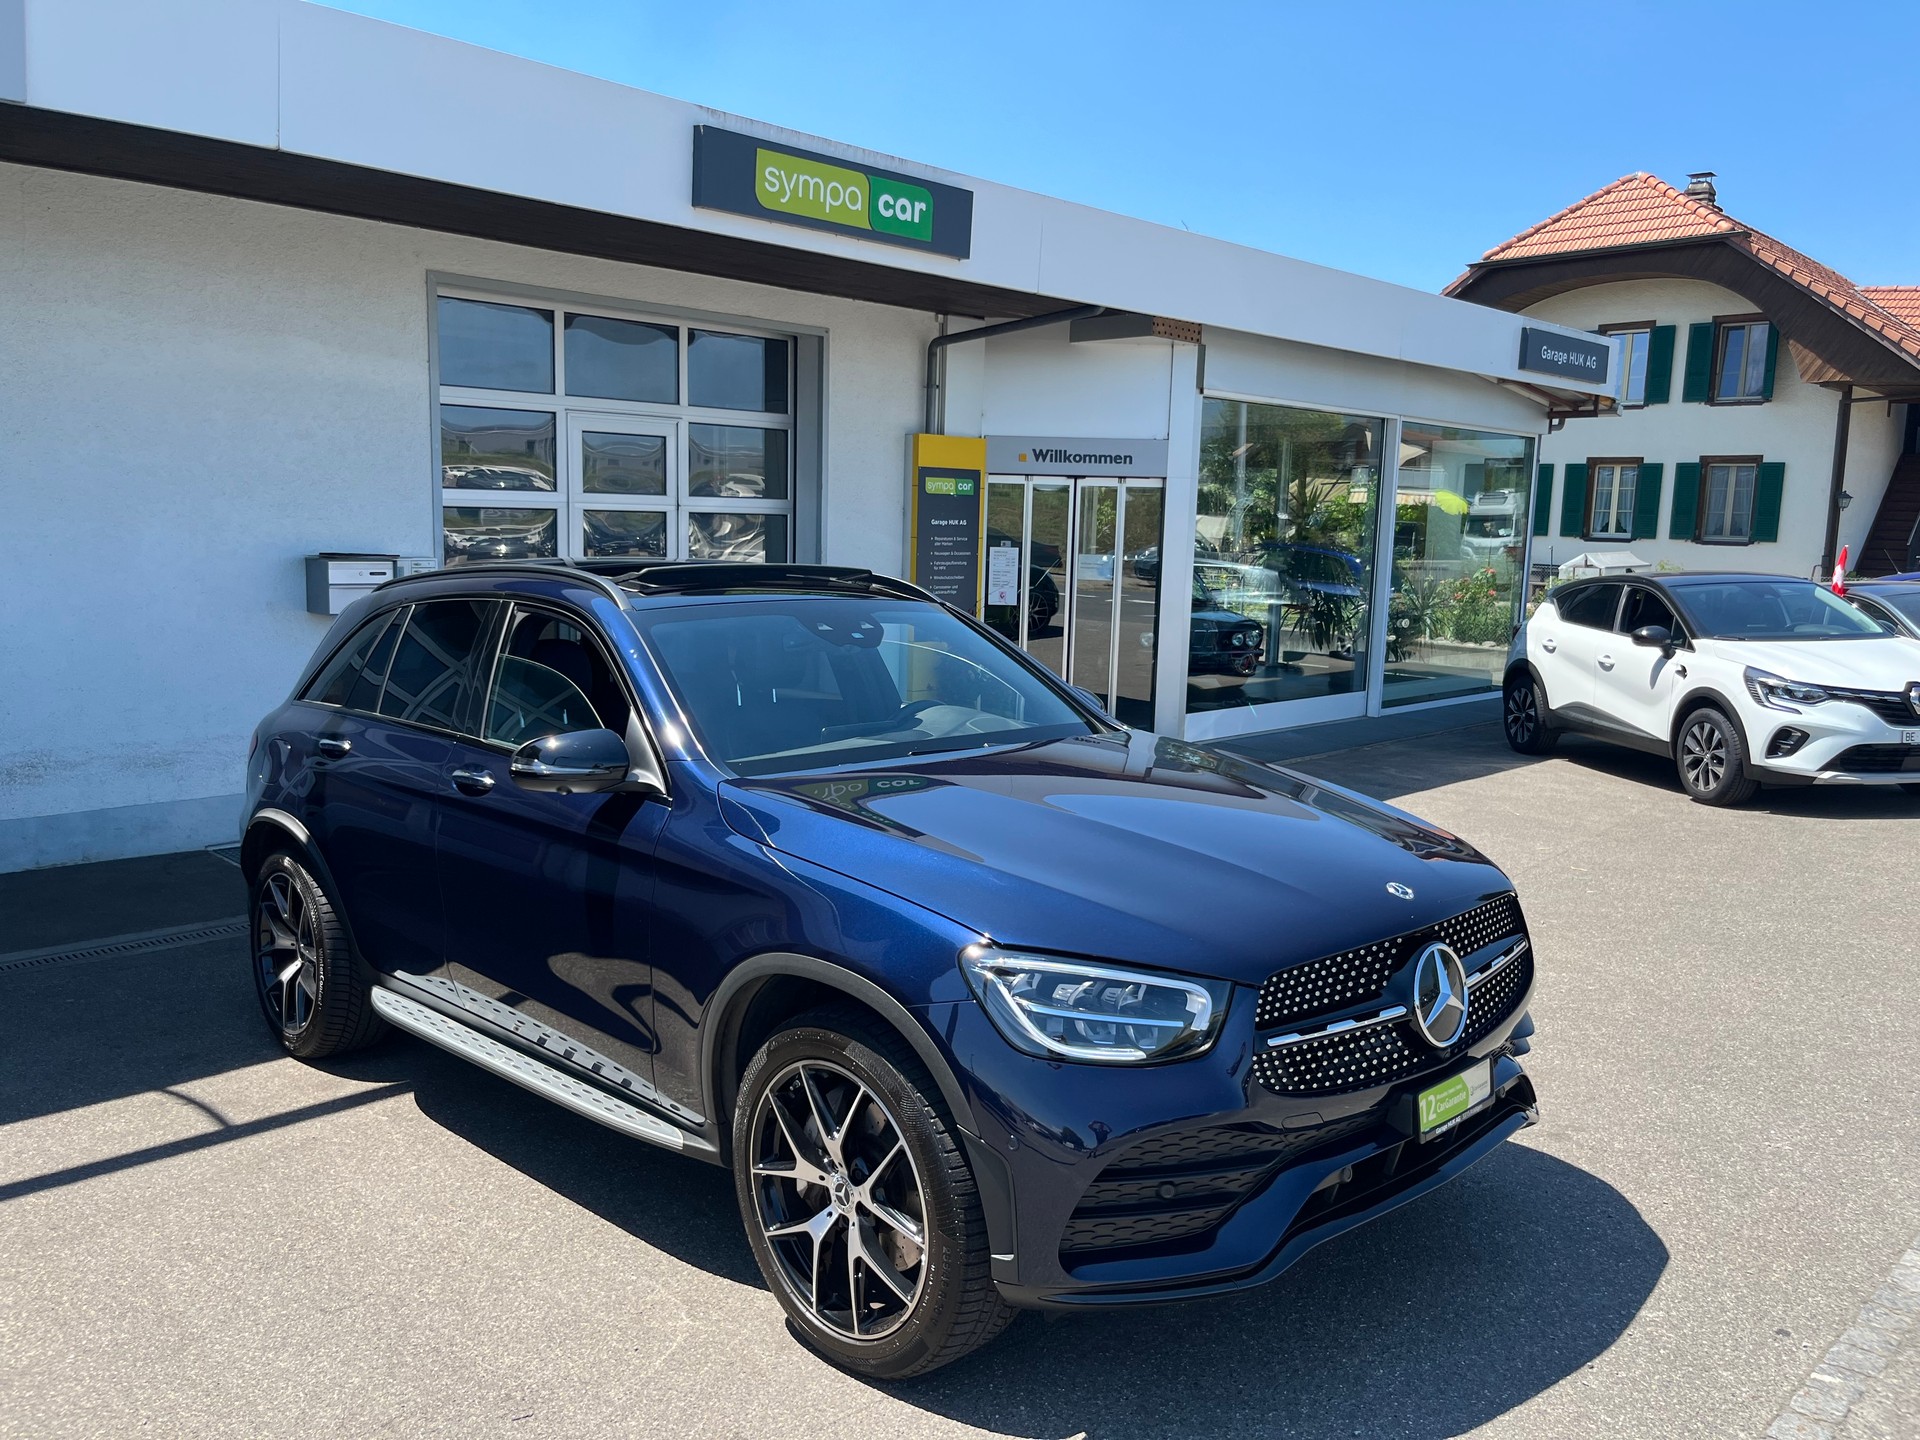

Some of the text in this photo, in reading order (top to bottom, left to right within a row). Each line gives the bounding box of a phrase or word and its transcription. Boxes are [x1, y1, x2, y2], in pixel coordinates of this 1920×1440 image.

[764, 166, 926, 224] sympa car
[1541, 345, 1597, 369] Garage HUK AG
[1031, 448, 1133, 465] Willkommen
[927, 481, 972, 492] sympa car
[930, 518, 948, 526] Garage
[1905, 731, 1916, 742] BE
[1419, 1094, 1437, 1124] 12
